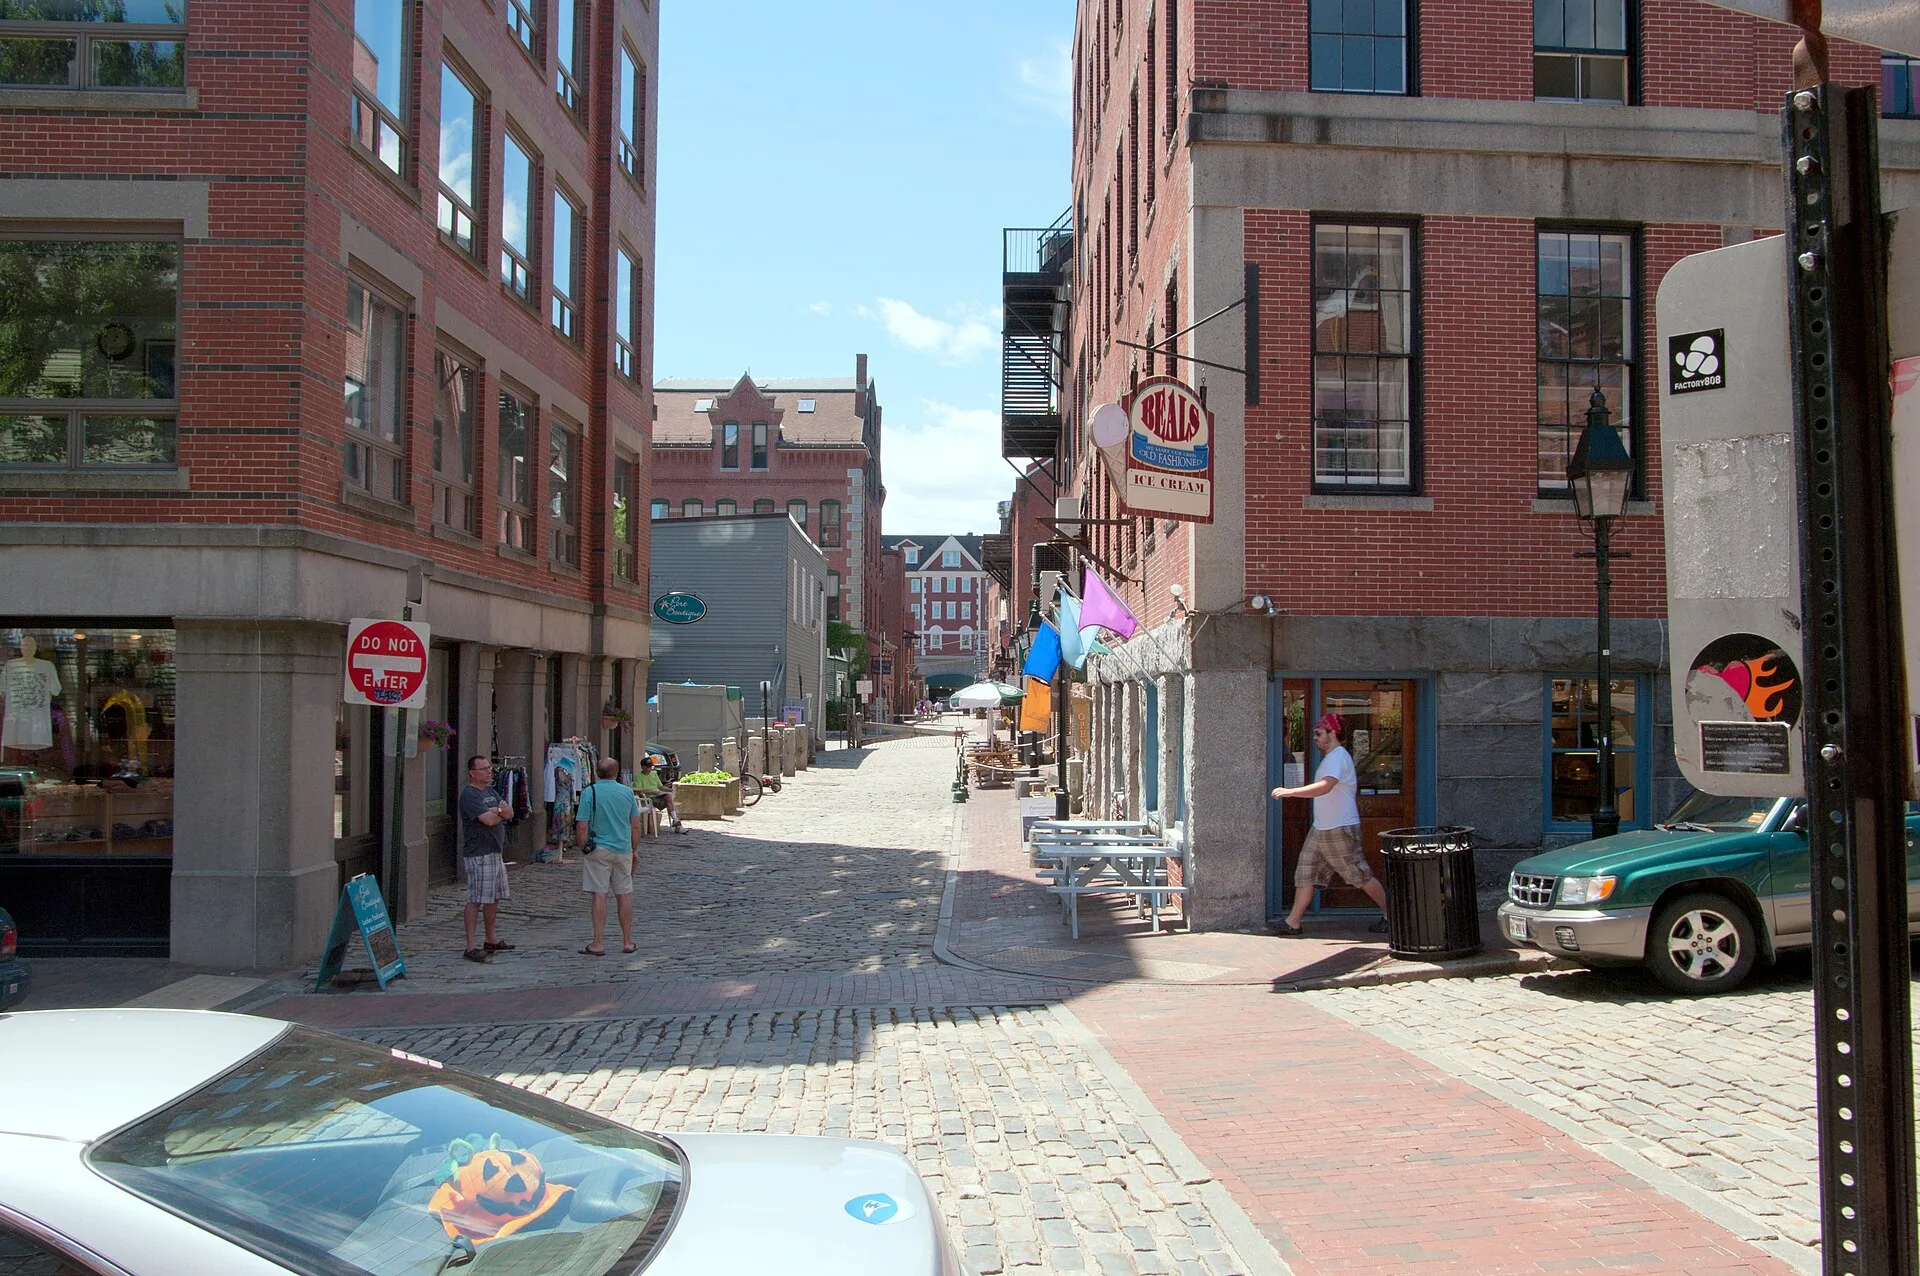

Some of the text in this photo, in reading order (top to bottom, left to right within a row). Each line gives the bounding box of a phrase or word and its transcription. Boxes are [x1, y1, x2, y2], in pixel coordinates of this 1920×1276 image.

[1674, 375, 1721, 390] FACTORY808
[1140, 387, 1200, 443] BEALS
[1138, 449, 1203, 467] OLD FASHIONED
[1134, 474, 1205, 493] ICE CREAM
[666, 605, 701, 620] Boutique
[361, 636, 417, 653] DO NOT
[363, 673, 408, 690] ENTER
[1077, 712, 1087, 748] OPEN
